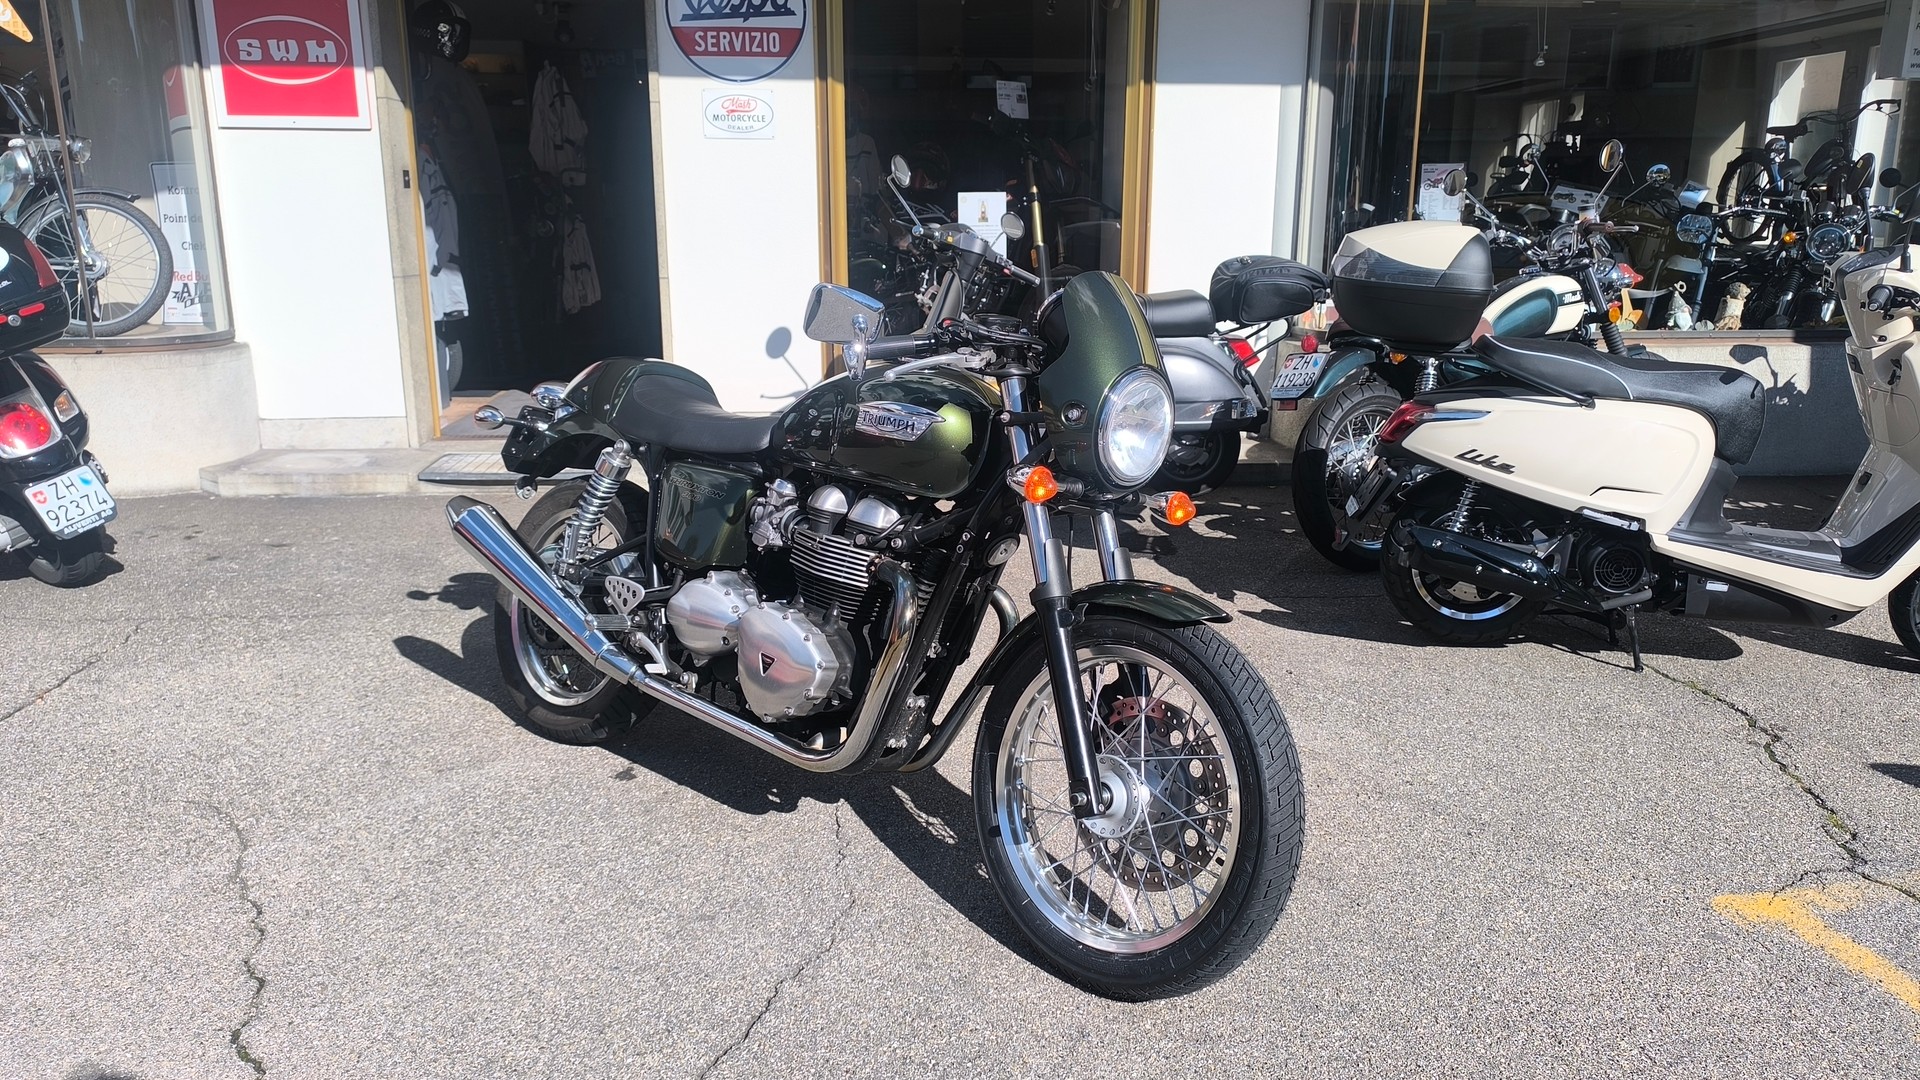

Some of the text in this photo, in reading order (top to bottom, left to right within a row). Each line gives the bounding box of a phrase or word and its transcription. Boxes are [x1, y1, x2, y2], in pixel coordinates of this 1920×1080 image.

[236, 39, 337, 62] SWM
[694, 31, 780, 53] SERVIZIO
[712, 114, 766, 122] MOTORCYCLE
[172, 271, 193, 281] Red
[1293, 355, 1314, 370] ZH
[1274, 372, 1316, 388] 119238
[862, 410, 916, 432] TRIUMPH
[47, 476, 80, 500] ZH
[670, 476, 727, 499] THRUXTON
[46, 490, 108, 527] 92374
[1142, 630, 1243, 739] LASERTEC
[1157, 850, 1257, 975] METZELER
